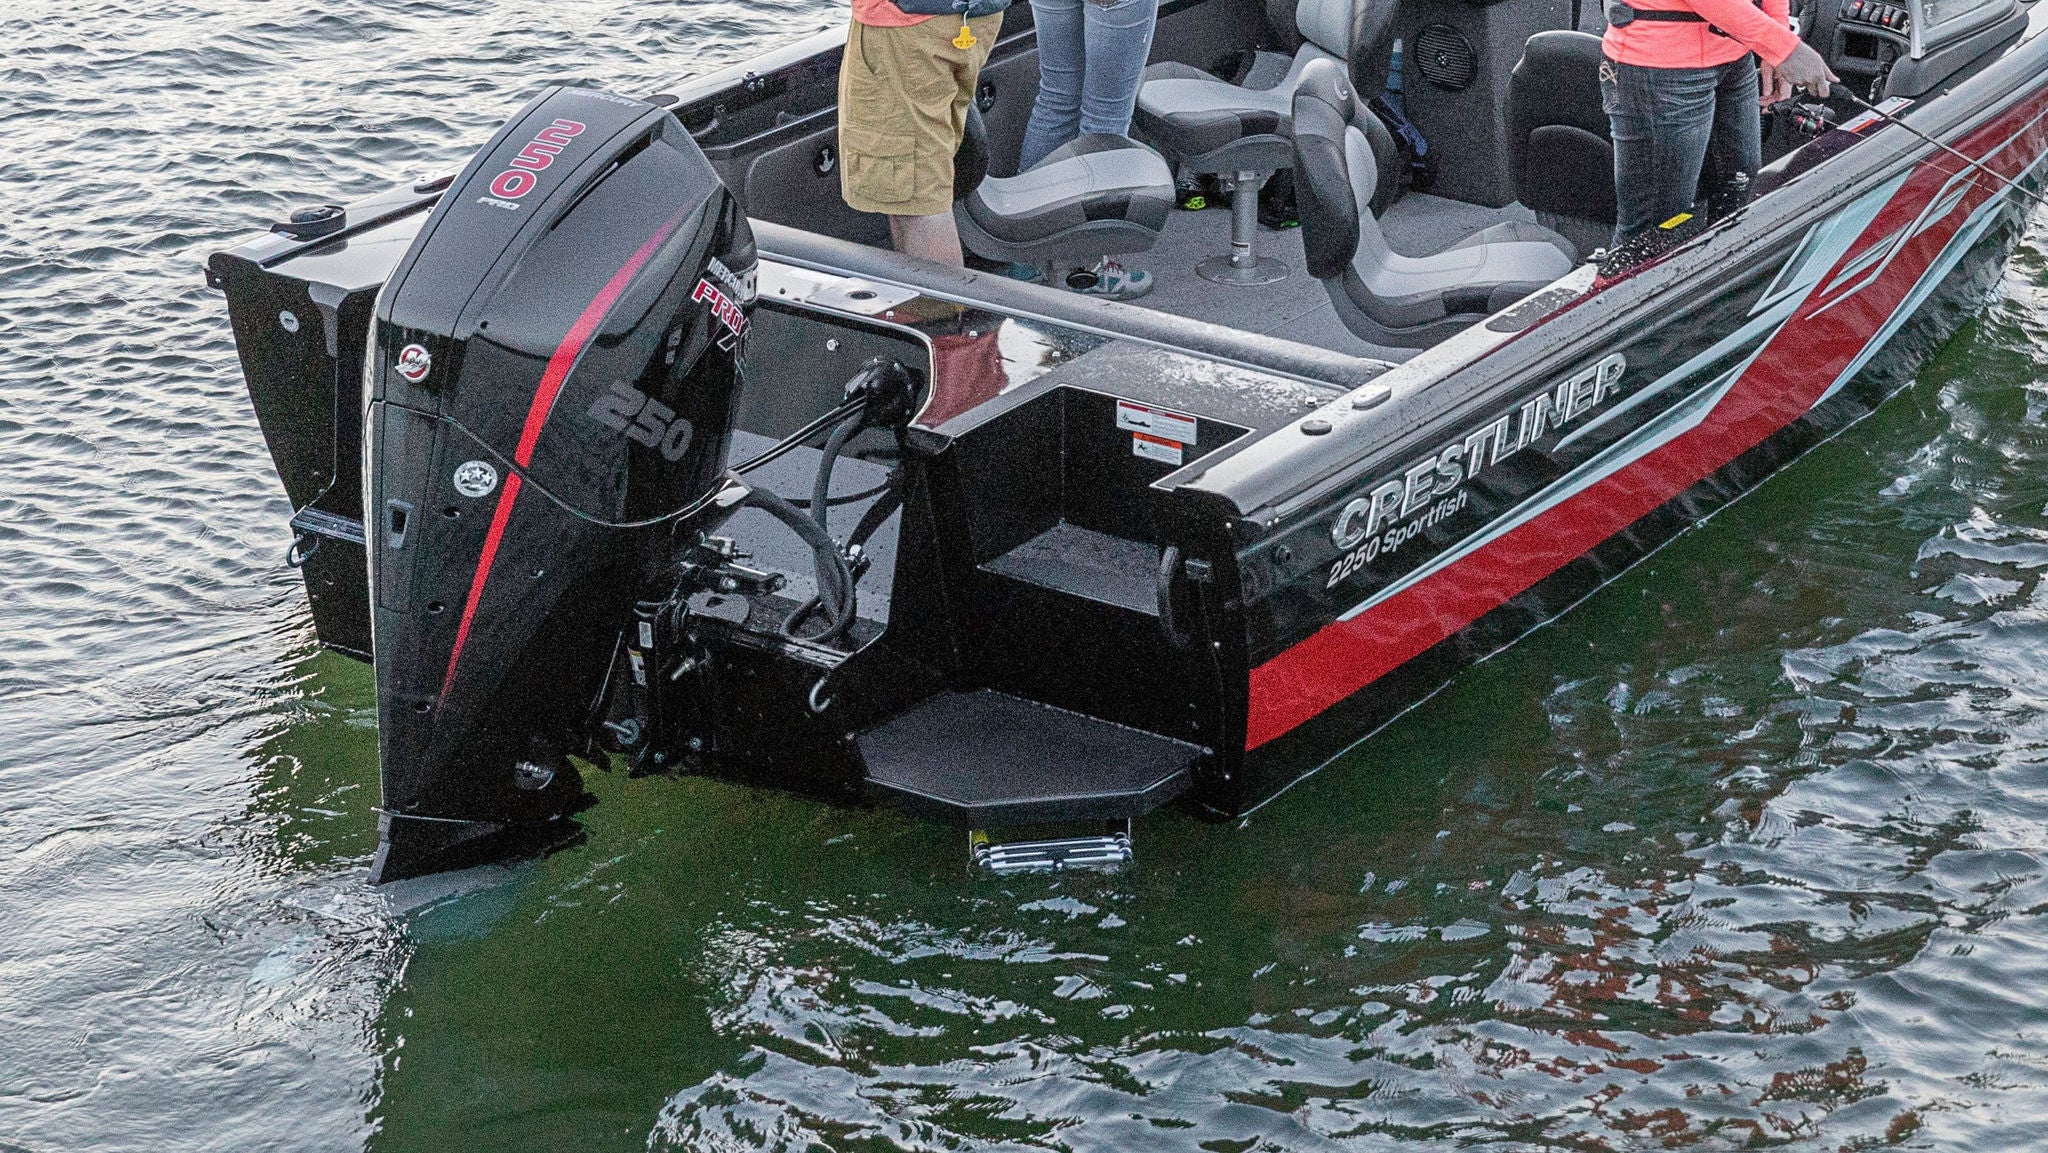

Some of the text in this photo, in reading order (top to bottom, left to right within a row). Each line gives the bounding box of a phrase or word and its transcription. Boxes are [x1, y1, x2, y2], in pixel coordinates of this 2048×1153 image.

[490, 118, 586, 199] 250
[476, 196, 520, 211] PRO
[691, 278, 744, 336] PRO
[587, 380, 694, 462] 250
[1330, 351, 1627, 550] CRESTLINER
[1325, 489, 1468, 590] 2250 Sportfish
